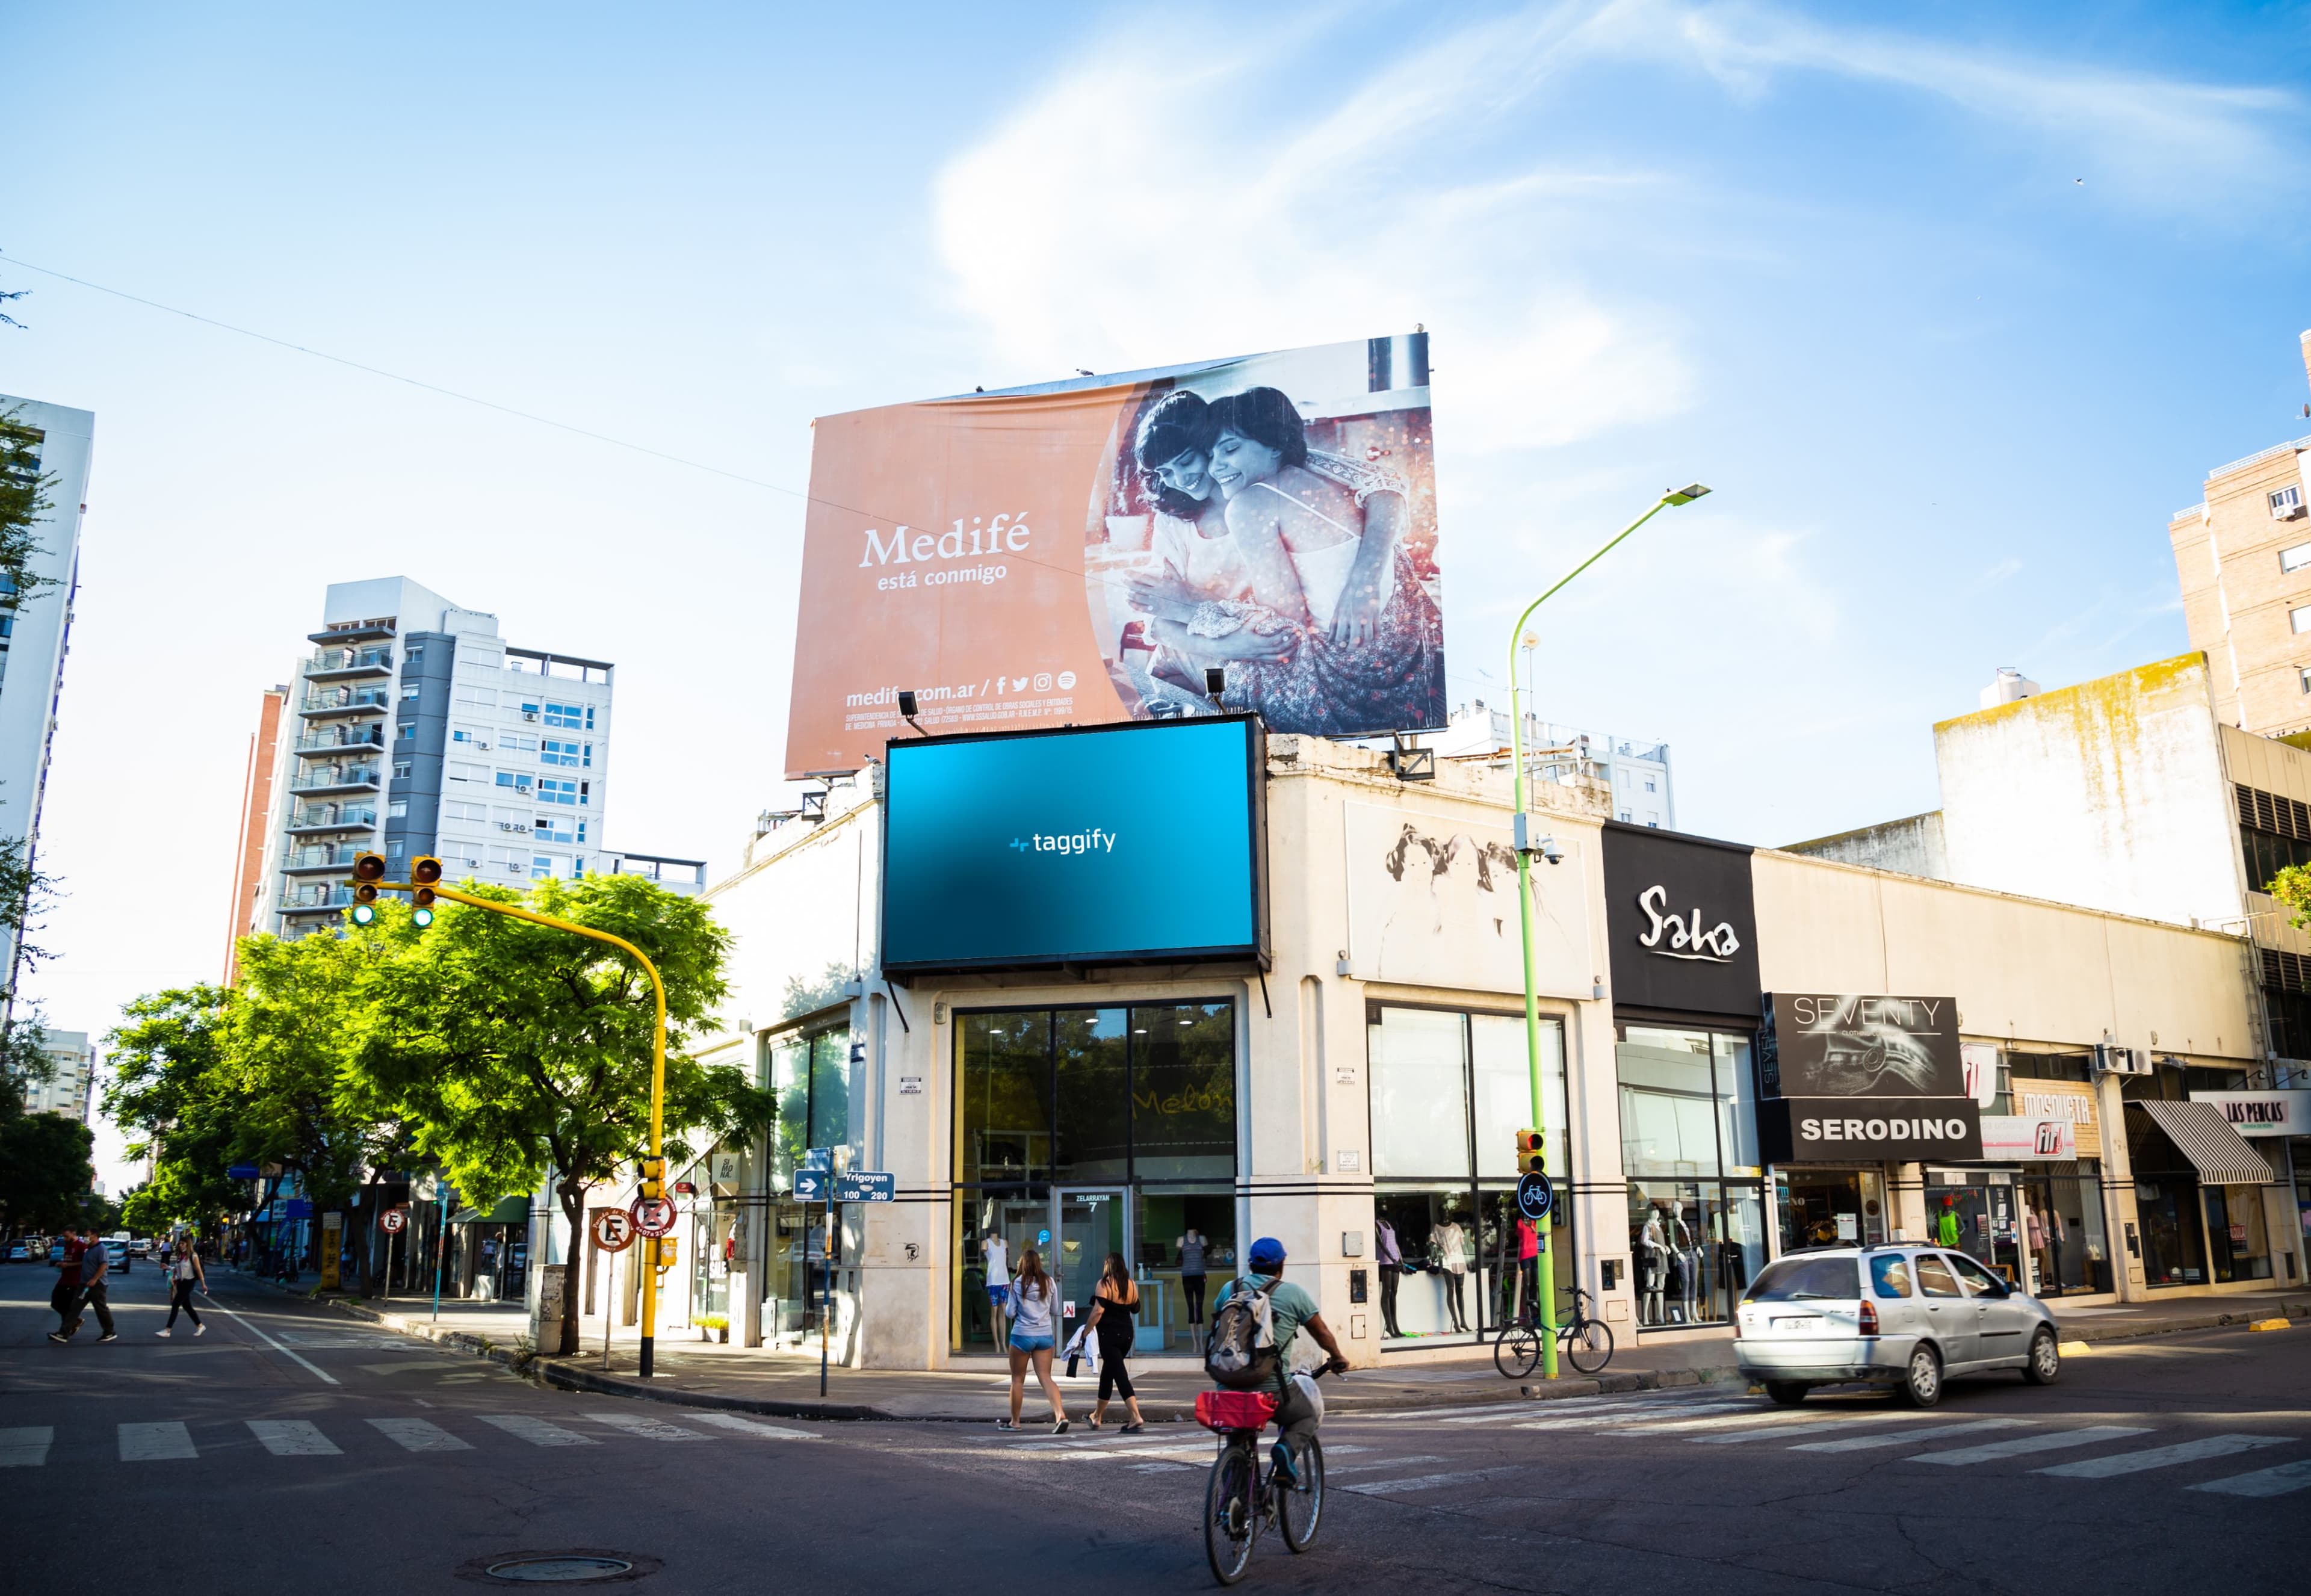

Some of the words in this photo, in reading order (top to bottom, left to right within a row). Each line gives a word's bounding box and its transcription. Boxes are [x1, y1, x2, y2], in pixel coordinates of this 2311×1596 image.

[859, 512, 1030, 568] Medifé
[877, 571, 918, 591] está
[924, 563, 1007, 585] conmigo
[846, 684, 976, 707] medifcom.ar
[928, 707, 943, 716] SALUD
[973, 703, 994, 711] CONTROL
[1003, 701, 1018, 710] OBRAS
[1019, 699, 1041, 708] SOCIALES
[1047, 697, 1073, 706] ENTIDADES
[853, 721, 875, 730] MEDICINA
[877, 719, 897, 728] PRIVADA
[924, 716, 939, 725] SALUD
[1033, 828, 1116, 855] taggify
[1639, 885, 1740, 956] Saha
[1794, 997, 1940, 1026] SEVENTY
[1131, 1083, 1233, 1120] Melón
[2226, 1103, 2245, 1123] LAS
[2245, 1102, 2284, 1123] PENCAS
[1801, 1118, 1967, 1140] SERODINO
[845, 1174, 888, 1184] Yrigoyen
[844, 1190, 860, 1199] 100
[1089, 1202, 1097, 1213] 7
